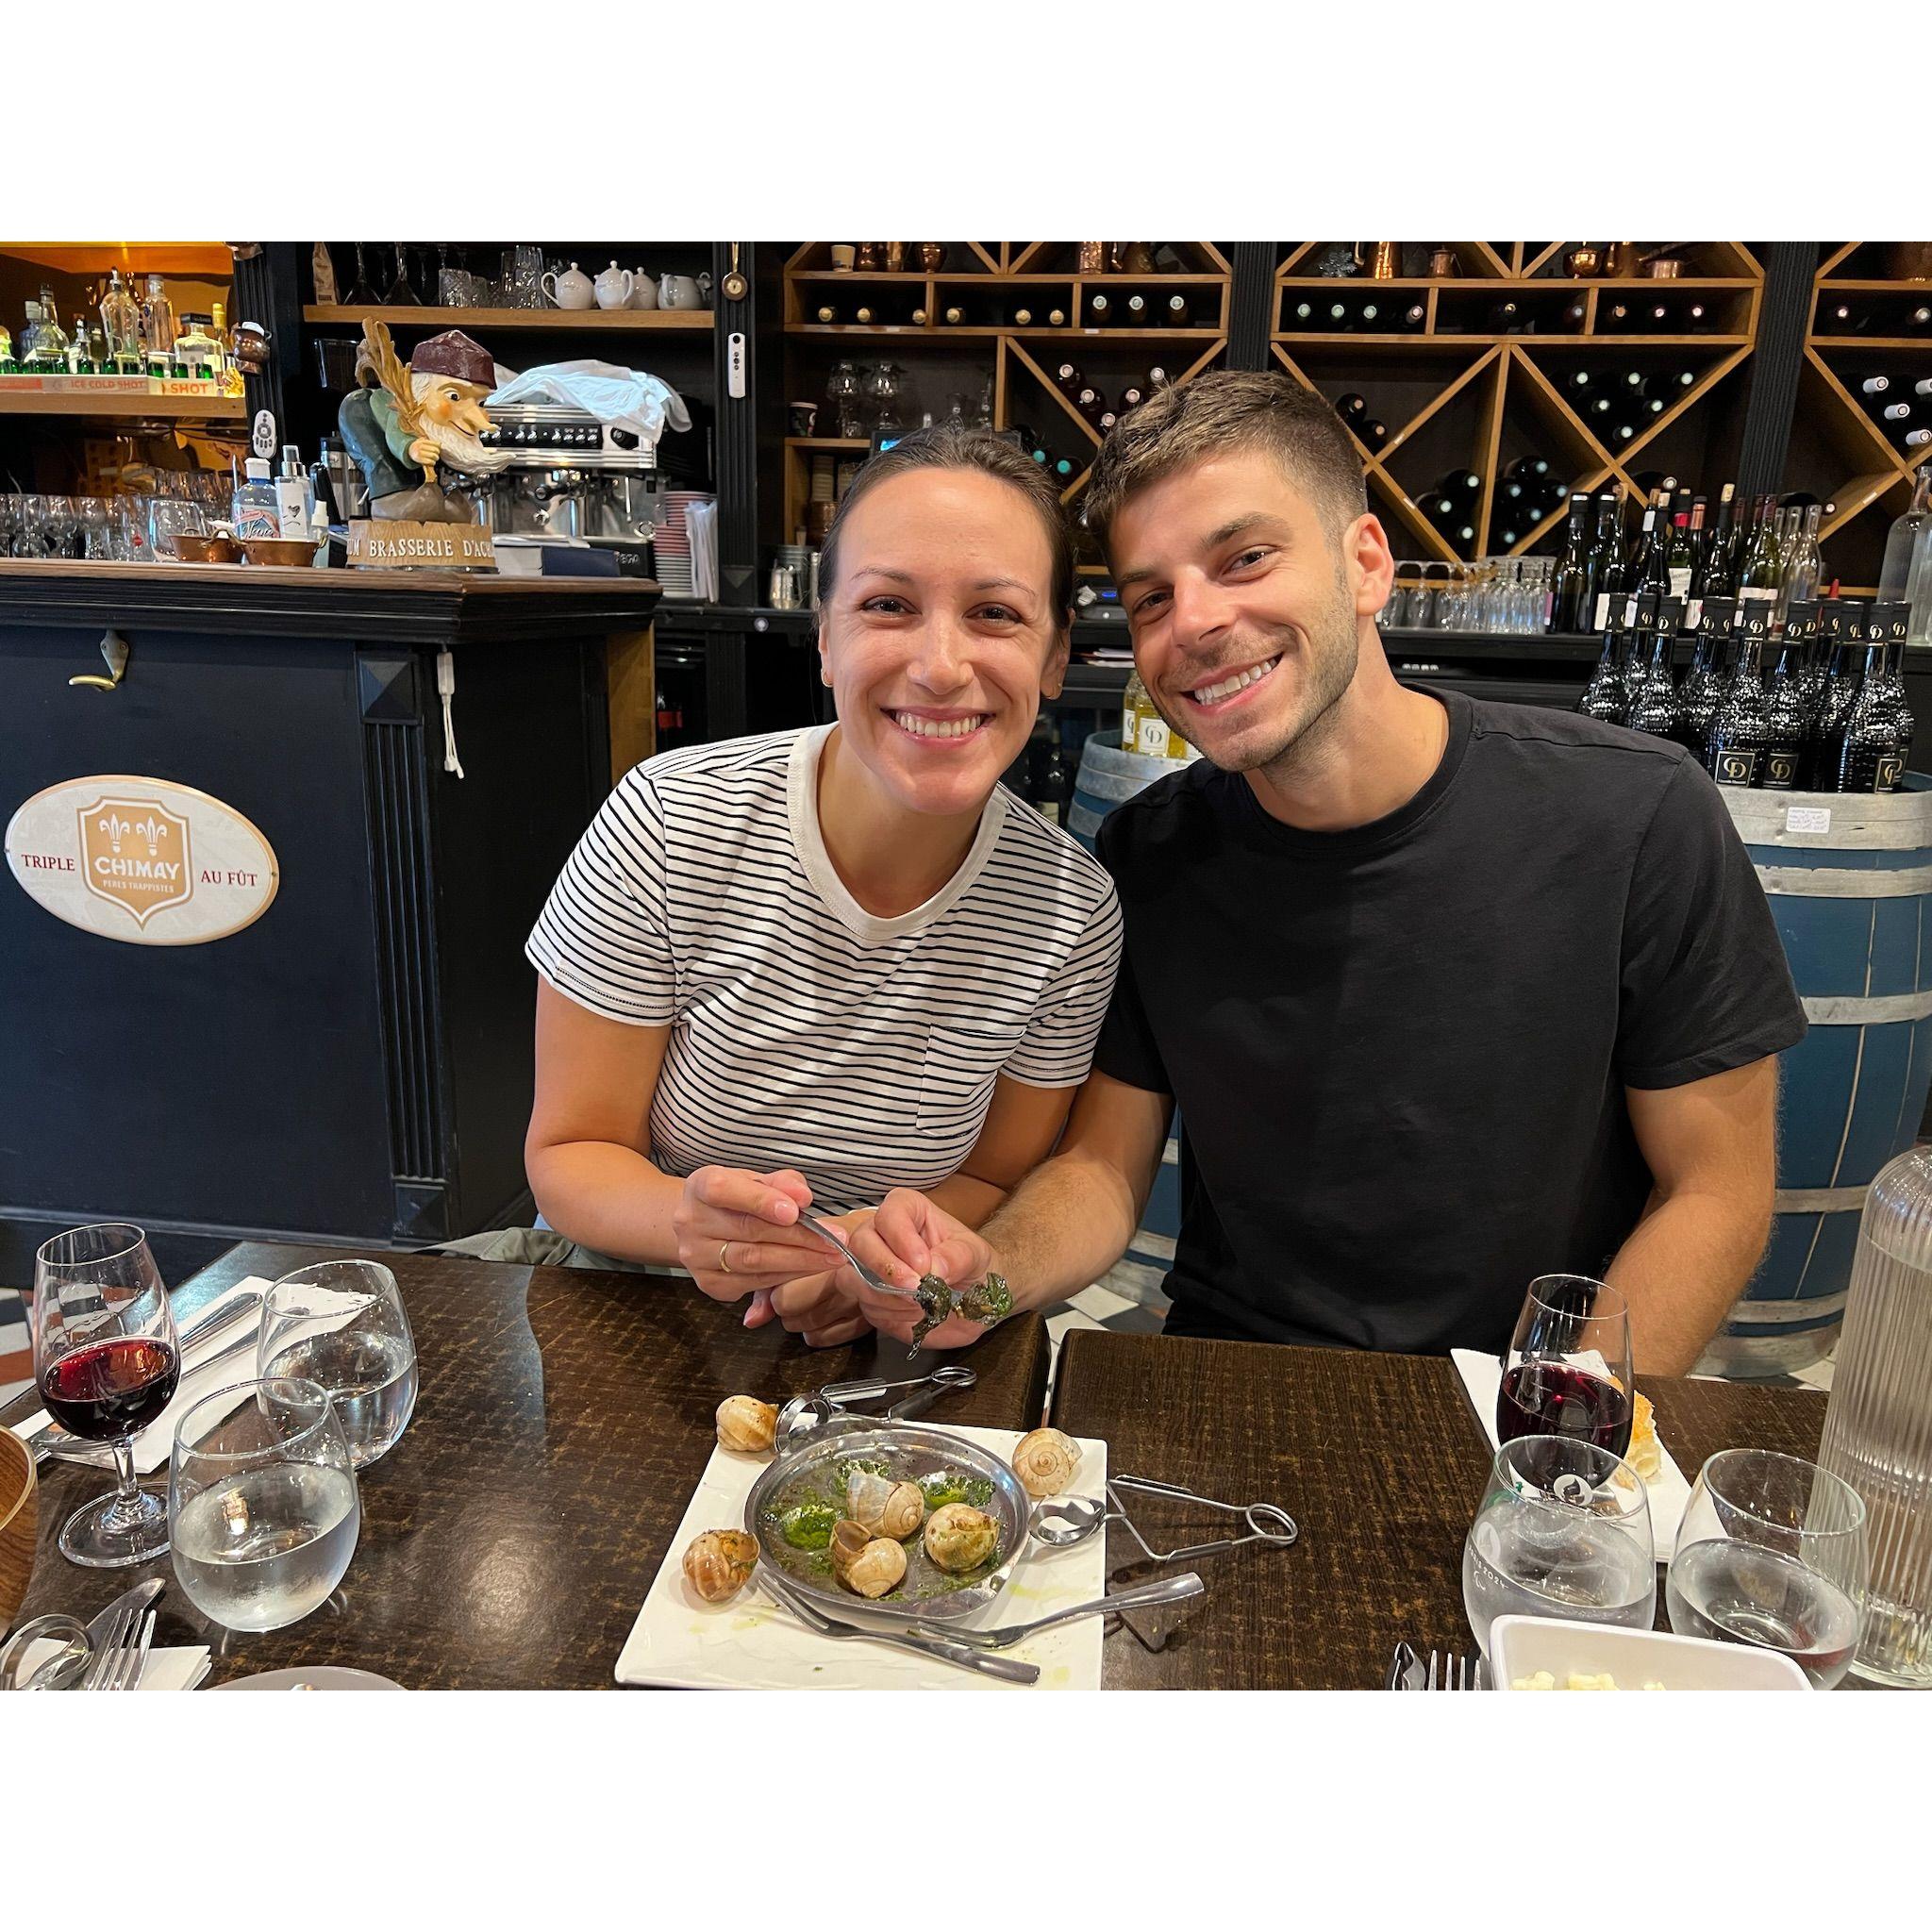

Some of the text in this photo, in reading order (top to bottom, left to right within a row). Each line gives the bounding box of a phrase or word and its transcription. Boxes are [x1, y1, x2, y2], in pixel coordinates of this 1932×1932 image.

[71, 379, 142, 390] ICE COLD SHOT
[170, 383, 208, 394] SHOT
[369, 539, 454, 558] BRASSERIE
[1145, 724, 1162, 743] CD
[1723, 757, 1746, 779] CD
[1770, 758, 1791, 781] CD
[21, 854, 75, 872] TRIPLE
[94, 856, 180, 880] CHIMAY
[201, 869, 258, 887] AU FÛT
[1483, 1566, 1509, 1589] 2024
